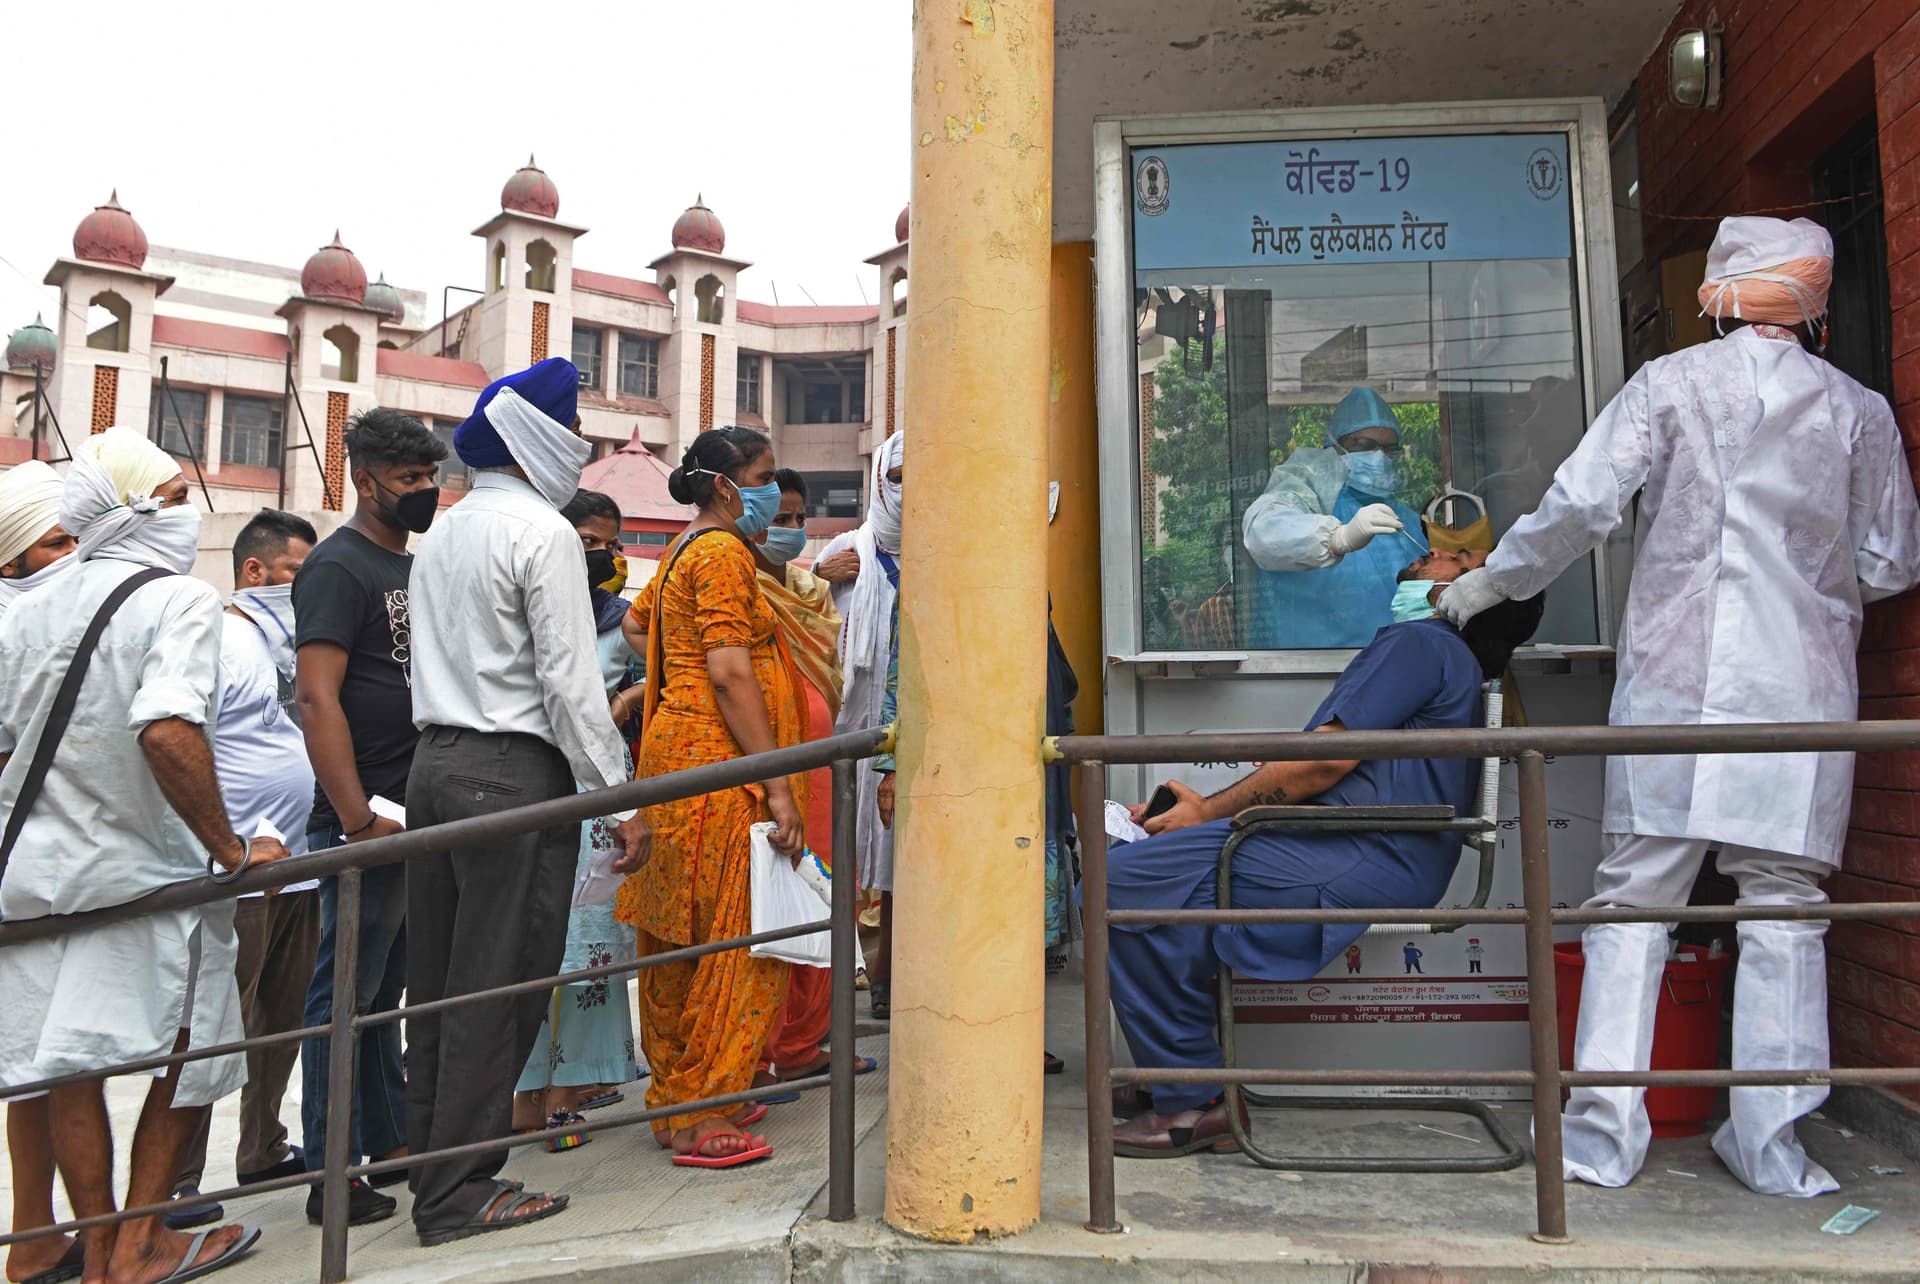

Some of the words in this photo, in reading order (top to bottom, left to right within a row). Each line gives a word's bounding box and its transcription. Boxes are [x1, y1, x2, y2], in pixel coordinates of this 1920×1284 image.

[1285, 147, 1410, 194] ਕੋਵਿਡ-19
[1251, 215, 1303, 255] ਸੈਂਪਲ
[1309, 212, 1395, 259] ਕੁਲੈਕਸ਼ਨ
[1401, 210, 1448, 251] ਸੈਂਟਰ
